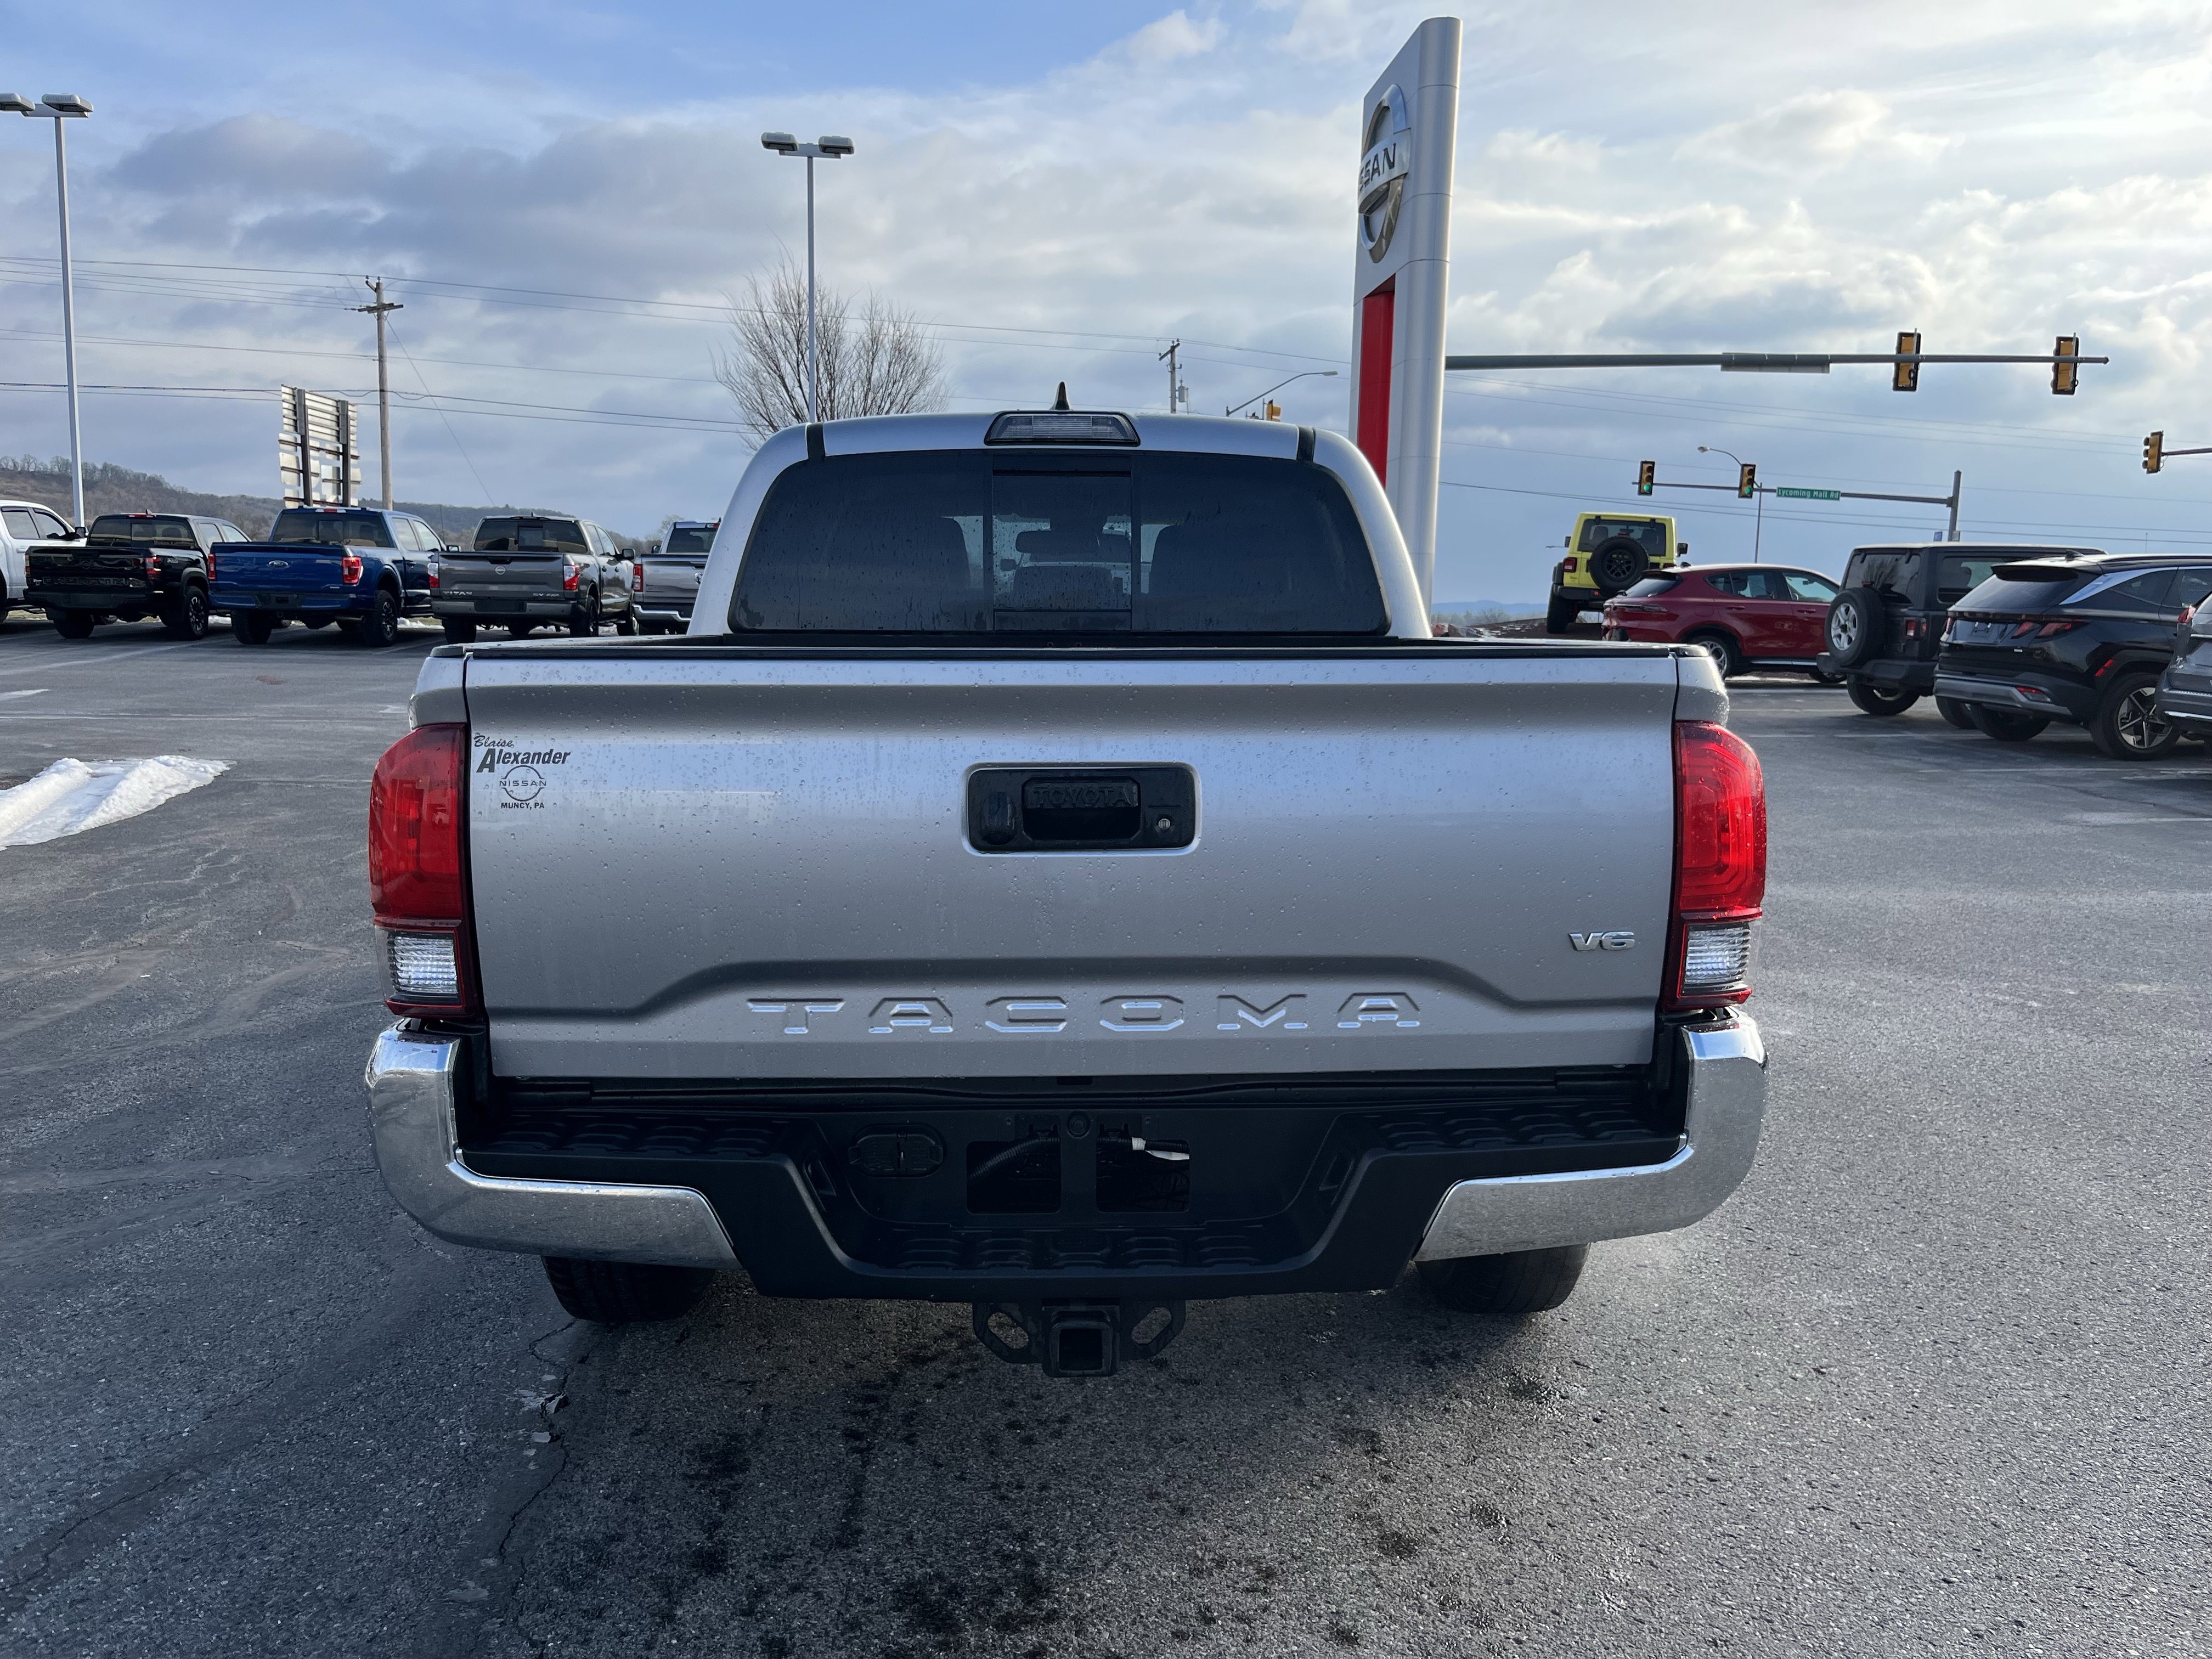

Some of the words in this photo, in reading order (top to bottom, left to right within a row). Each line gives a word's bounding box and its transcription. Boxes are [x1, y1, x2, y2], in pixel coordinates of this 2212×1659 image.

[1779, 488, 1811, 499] Lycoming
[1813, 490, 1827, 499] Mall
[473, 735, 514, 748] Blaise
[476, 748, 571, 773] Alexander
[1033, 786, 1132, 807] TOYOTA
[1568, 930, 1635, 951] V6
[747, 992, 1420, 1034] TACOMA
